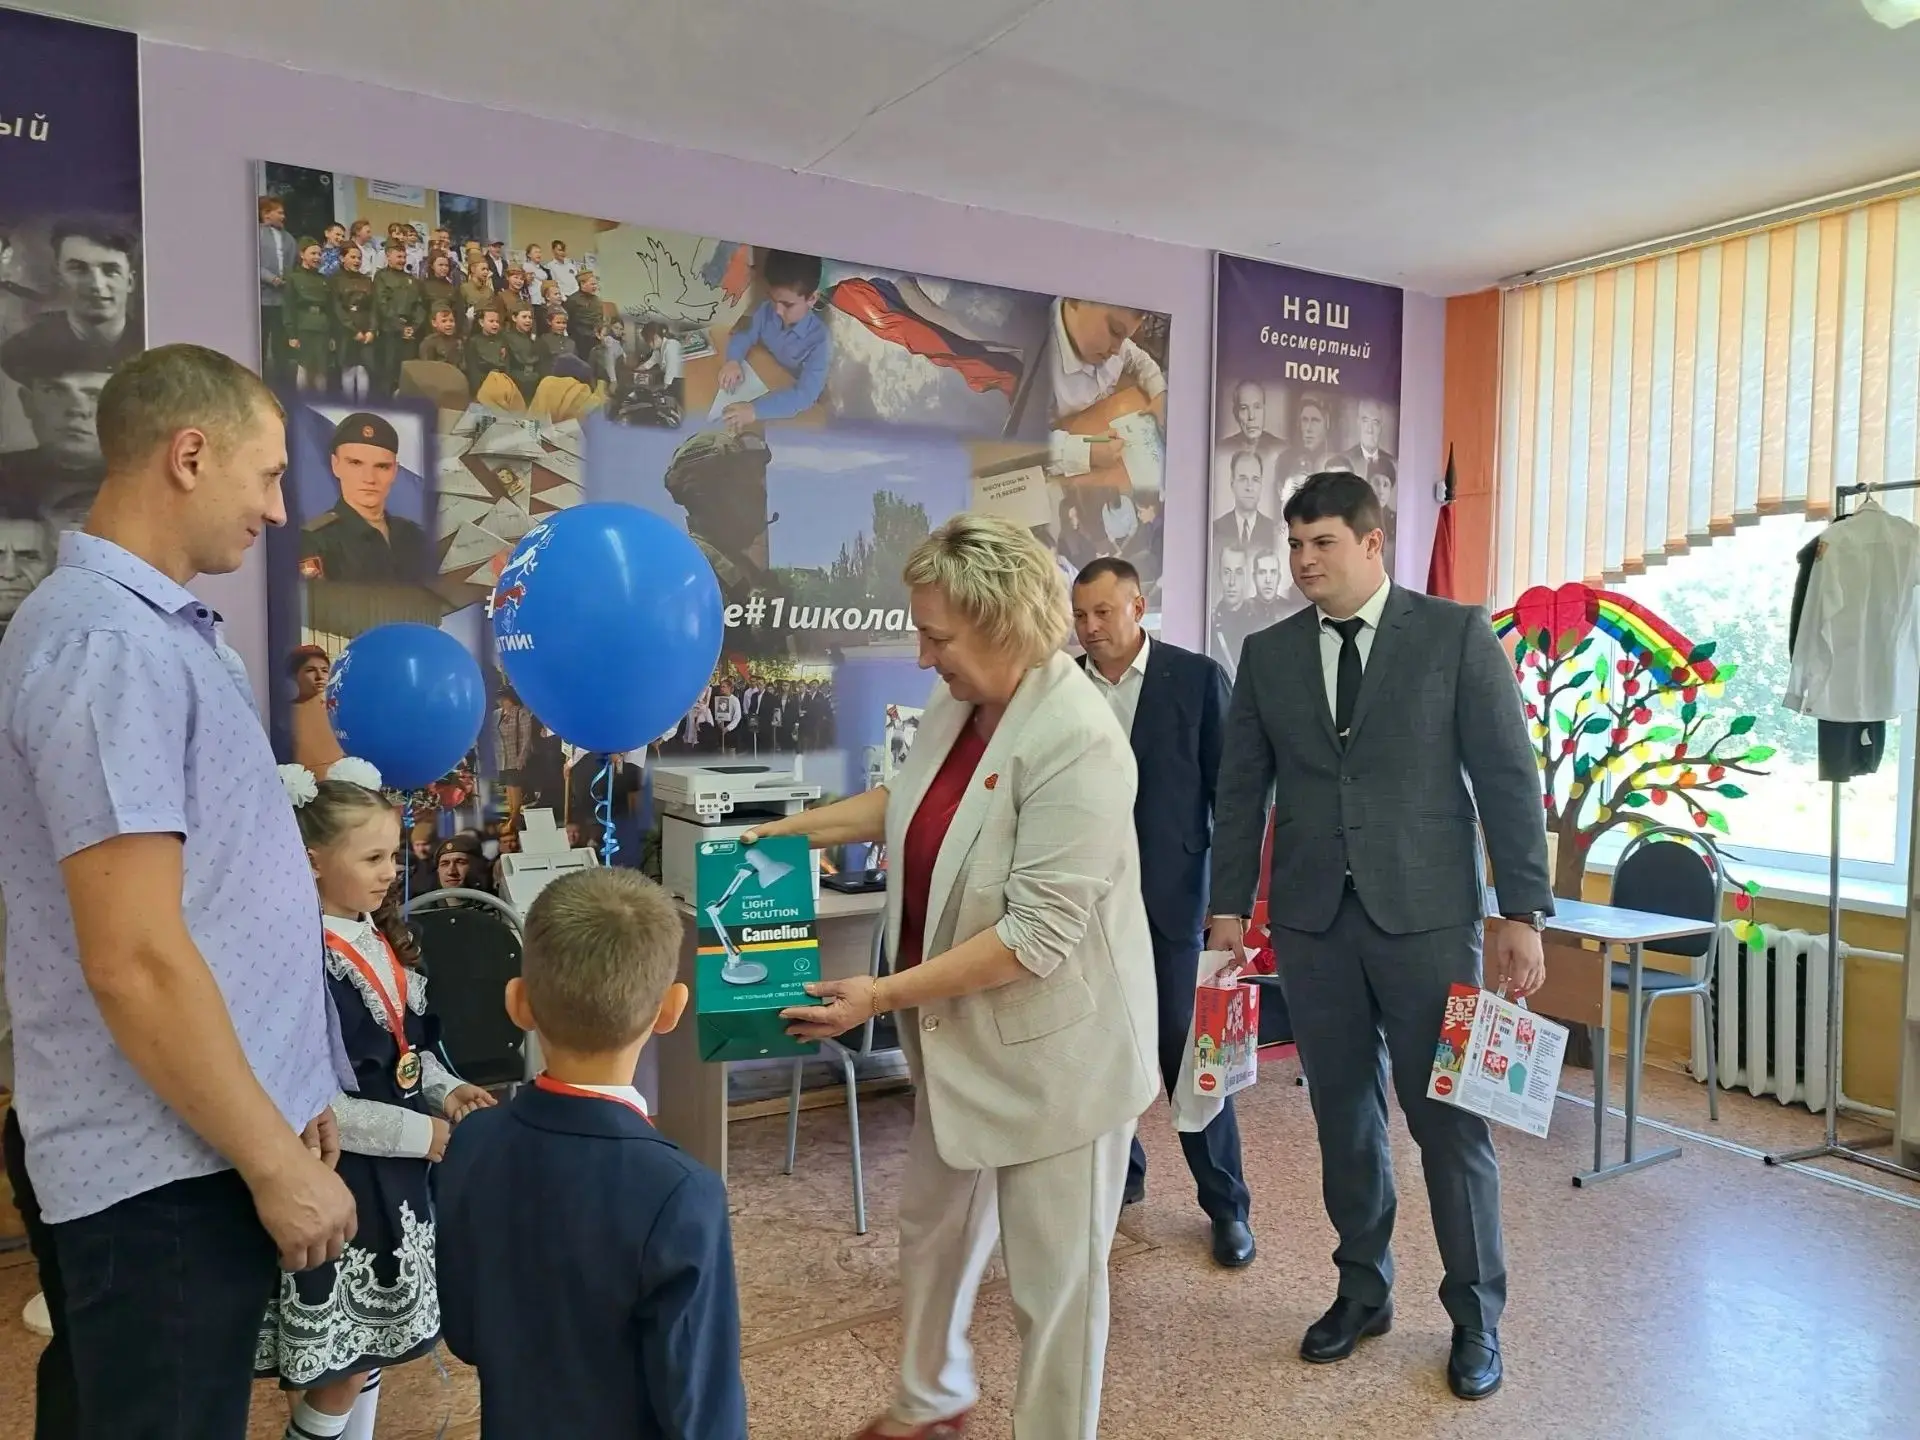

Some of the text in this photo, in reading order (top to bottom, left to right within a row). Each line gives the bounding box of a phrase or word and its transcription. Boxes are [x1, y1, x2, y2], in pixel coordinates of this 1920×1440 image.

[1260, 326, 1371, 359] бессмертный
[1285, 361, 1340, 385] полк
[742, 899, 775, 910] LIGHT
[742, 908, 799, 920] SOLUTION
[742, 925, 809, 943] Camelion
